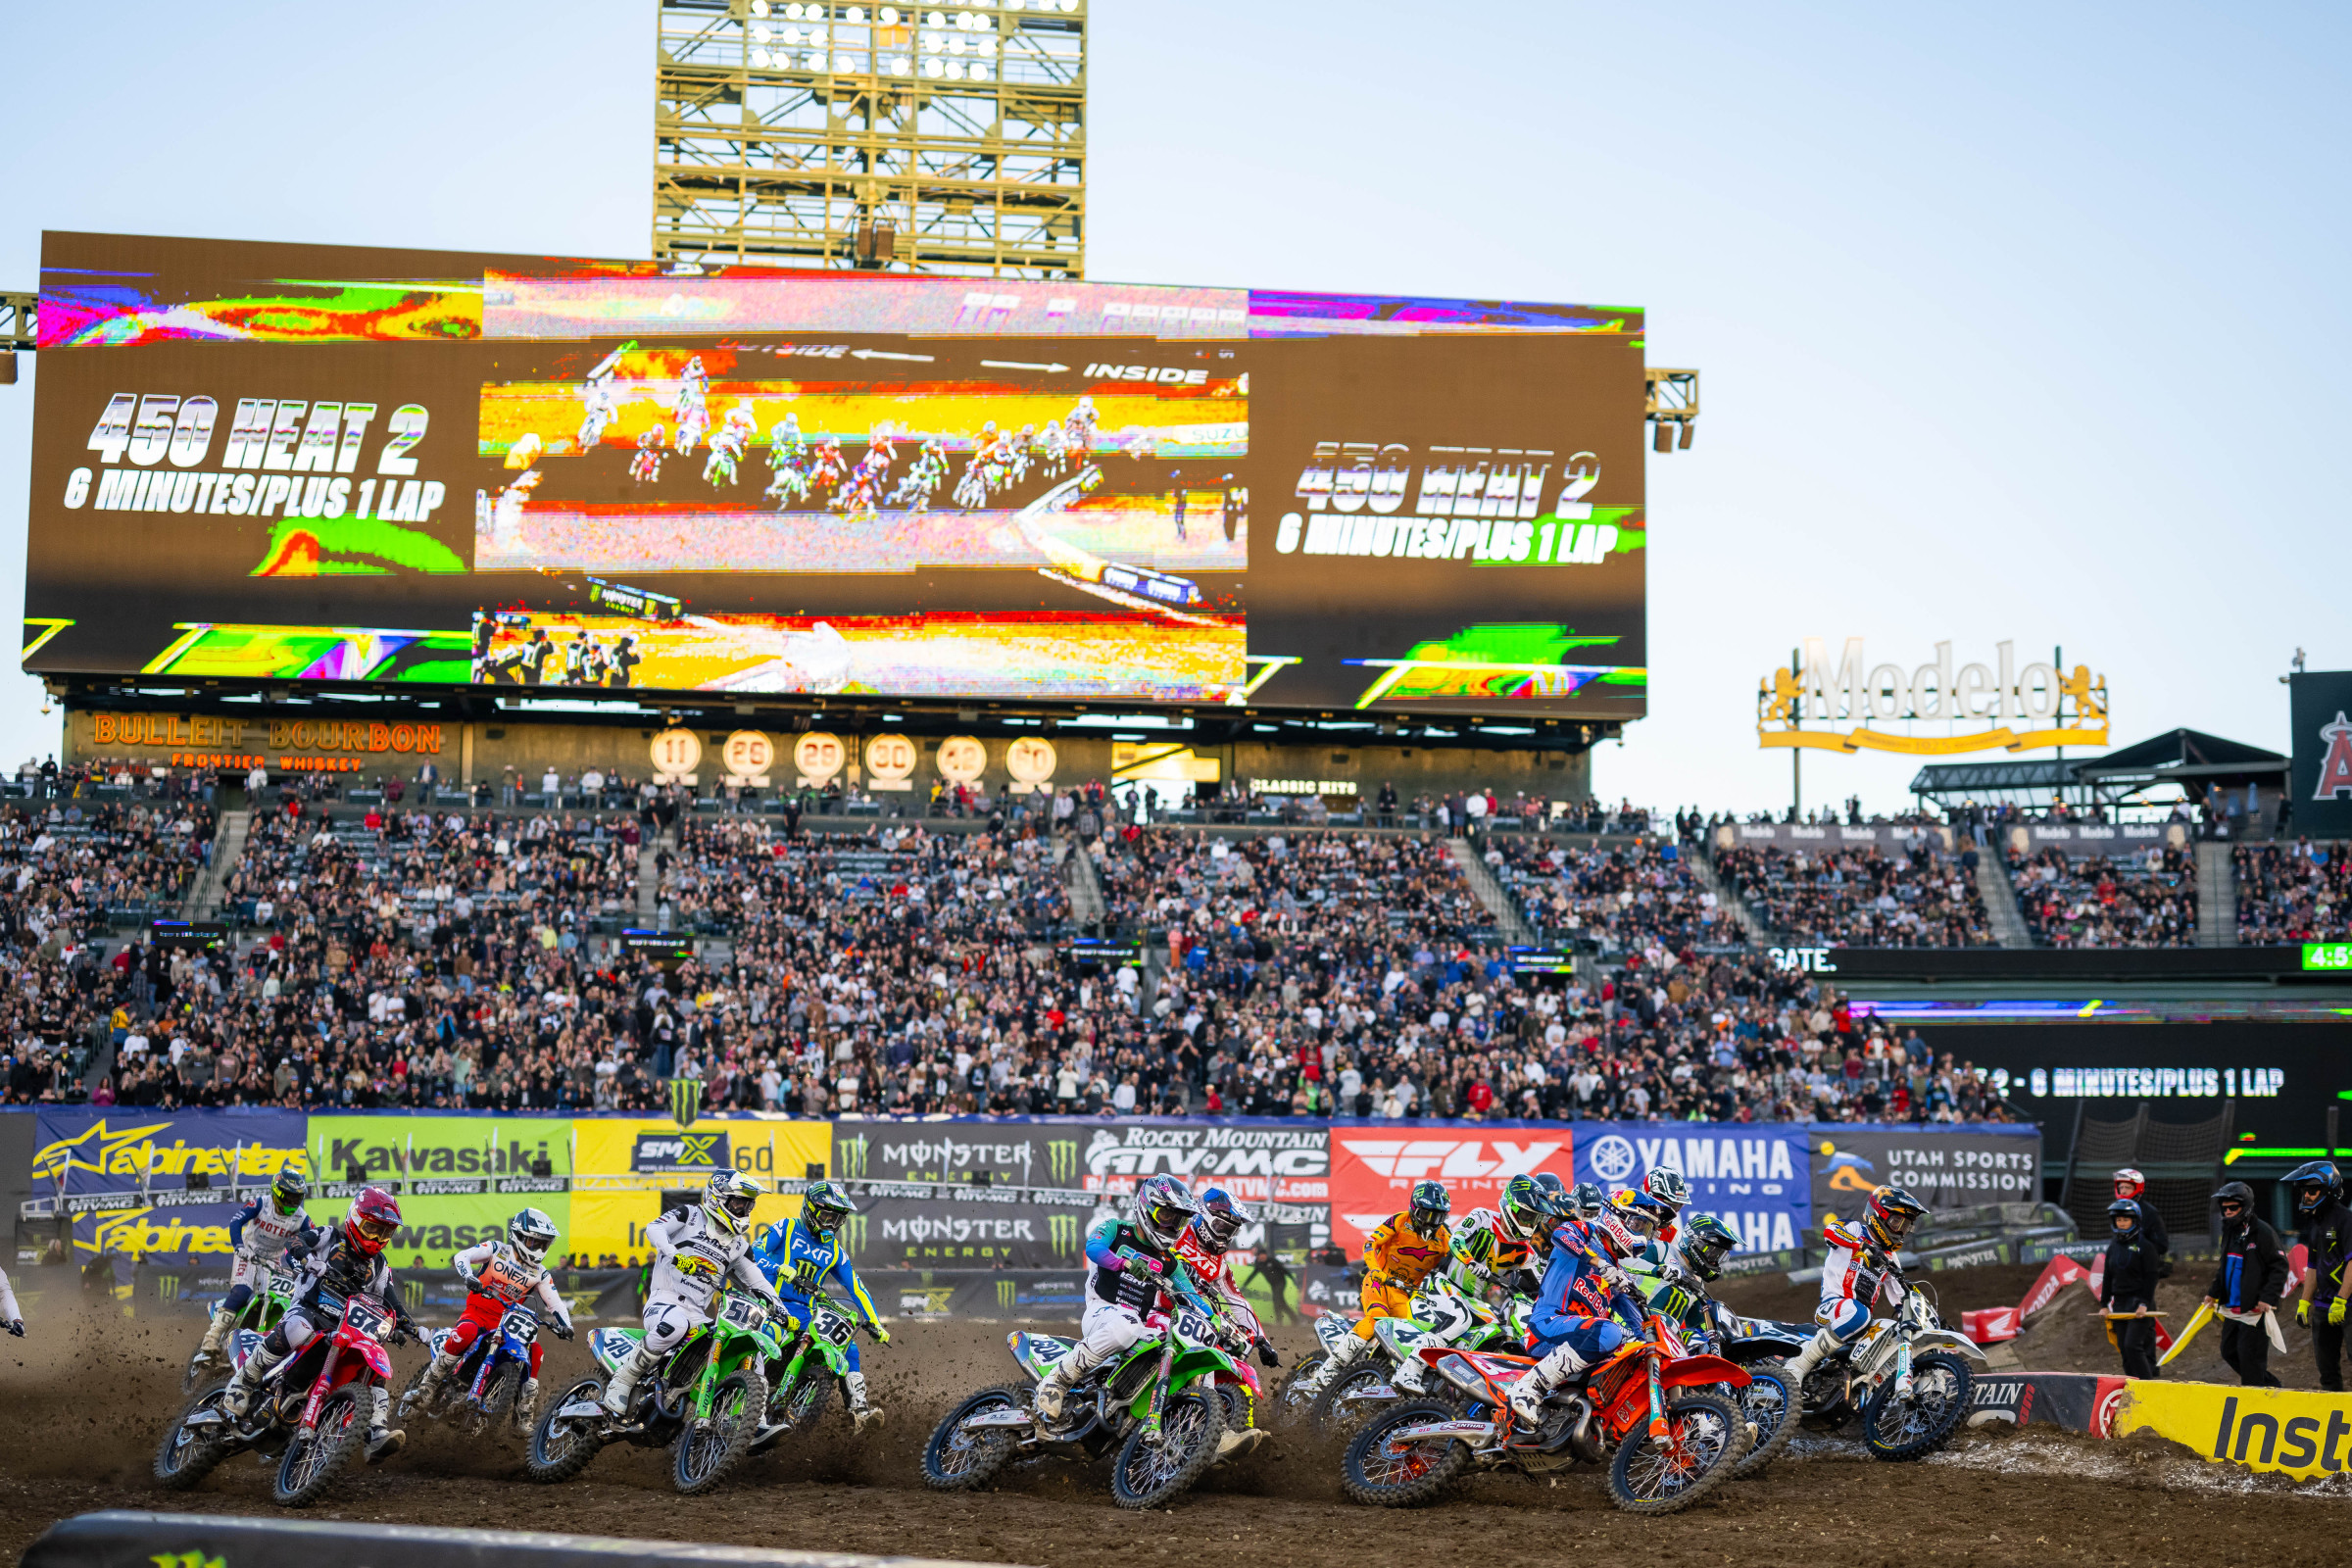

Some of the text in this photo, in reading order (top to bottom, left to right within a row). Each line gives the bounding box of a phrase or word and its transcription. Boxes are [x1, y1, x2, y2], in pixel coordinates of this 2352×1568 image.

[1083, 364, 1209, 384] INSIDE
[87, 393, 430, 475] 450 HEAT 2
[1296, 442, 1601, 519] 450 HEAT 2
[64, 467, 446, 523] 6 MINUTES/PLUS 1 LAP
[1275, 513, 1619, 564] 6 MINUTES/PLUS 1 LAP
[1804, 637, 2060, 719] Modelo
[95, 714, 441, 754] BULLEIT BOURBON
[172, 753, 362, 773] FRONTIER WHISKEY
[663, 740, 685, 764] 11
[803, 743, 836, 767] 29
[874, 745, 907, 769] 30
[944, 750, 976, 771] 42
[1250, 779, 1357, 796] CLASSIC HITS
[1768, 947, 1838, 972] GATE.
[2310, 946, 2352, 968] 4:5
[2030, 1067, 2048, 1098] 6
[2052, 1067, 2220, 1099] MINUTES/PLUS
[2223, 1068, 2236, 1098] 1
[2241, 1067, 2285, 1098] LAP
[639, 1136, 718, 1166] SMX
[1126, 1127, 1328, 1150] ROCKY MOUNTAIN
[109, 1140, 307, 1184] alpinestars
[331, 1139, 549, 1173] Kawasaki
[883, 1140, 1033, 1168] MONSTER
[1341, 1140, 1563, 1177] FLY
[1637, 1138, 1794, 1180] YAMAHA
[1887, 1150, 2034, 1171] UTAH SPORTS
[906, 1171, 1011, 1182] ENERY
[1389, 1179, 1512, 1190] RCING
[1887, 1170, 2034, 1191] COMMISSION
[882, 1215, 1035, 1243] MONSTER
[791, 1238, 834, 1265] FXR
[906, 1248, 1012, 1257] ENERGY
[1177, 1244, 1217, 1277] FXR
[1334, 1290, 1360, 1306] TR
[347, 1305, 383, 1341] 87
[504, 1314, 539, 1344] 63
[726, 1299, 764, 1332] 519
[814, 1311, 852, 1347] 36
[1178, 1314, 1217, 1348] 604
[1321, 1323, 1344, 1342] 21
[1396, 1328, 1421, 1345] 4
[604, 1337, 634, 1359] 519
[1030, 1339, 1068, 1363] 604
[2214, 1396, 2352, 1472] Inst
